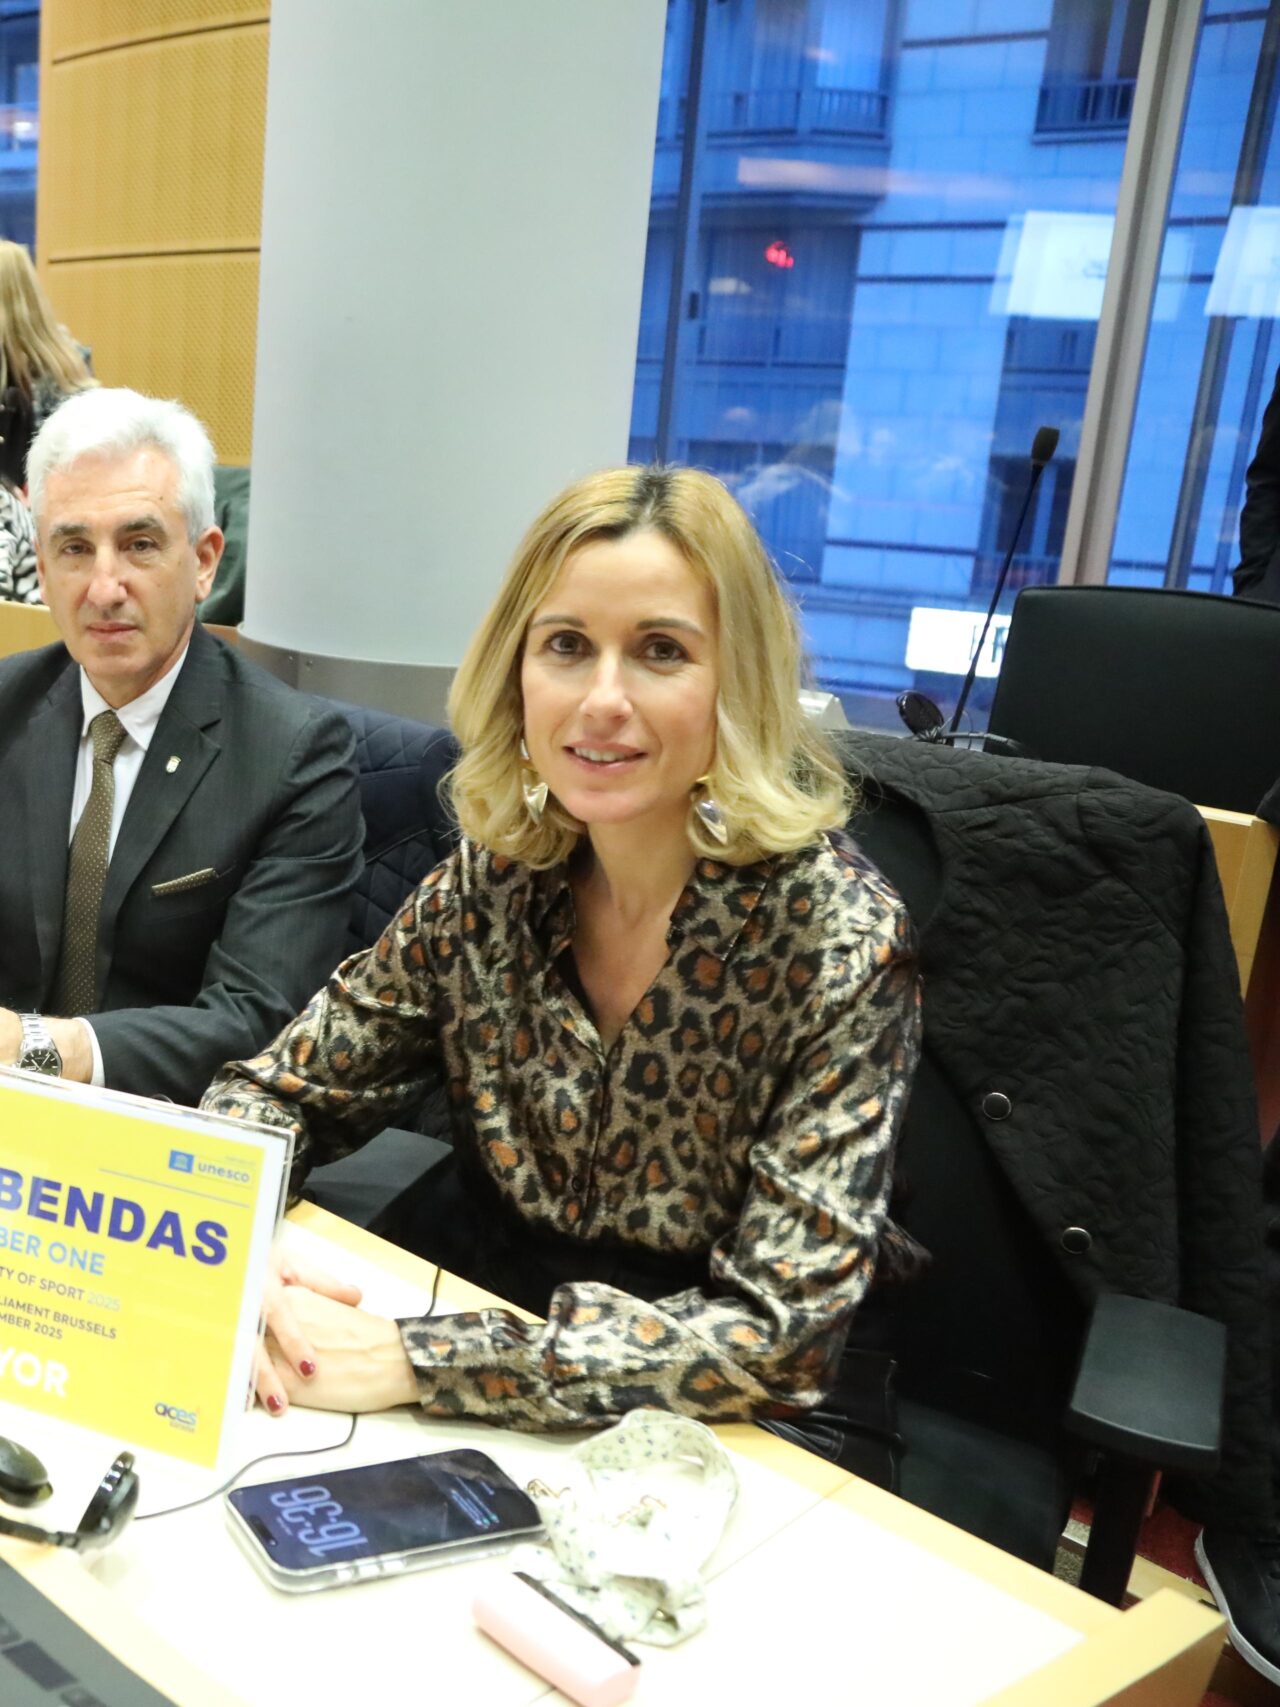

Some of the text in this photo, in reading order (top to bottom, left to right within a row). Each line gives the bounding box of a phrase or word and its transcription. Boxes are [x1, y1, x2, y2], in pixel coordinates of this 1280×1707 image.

[198, 1161, 250, 1183] unesco
[48, 1241, 106, 1276] ONE
[17, 1271, 37, 1286] OF
[39, 1278, 86, 1301] SPORT
[34, 1322, 63, 1340] 2025
[53, 1311, 117, 1340] BRUSSELS
[271, 1485, 368, 1557] 16:36
